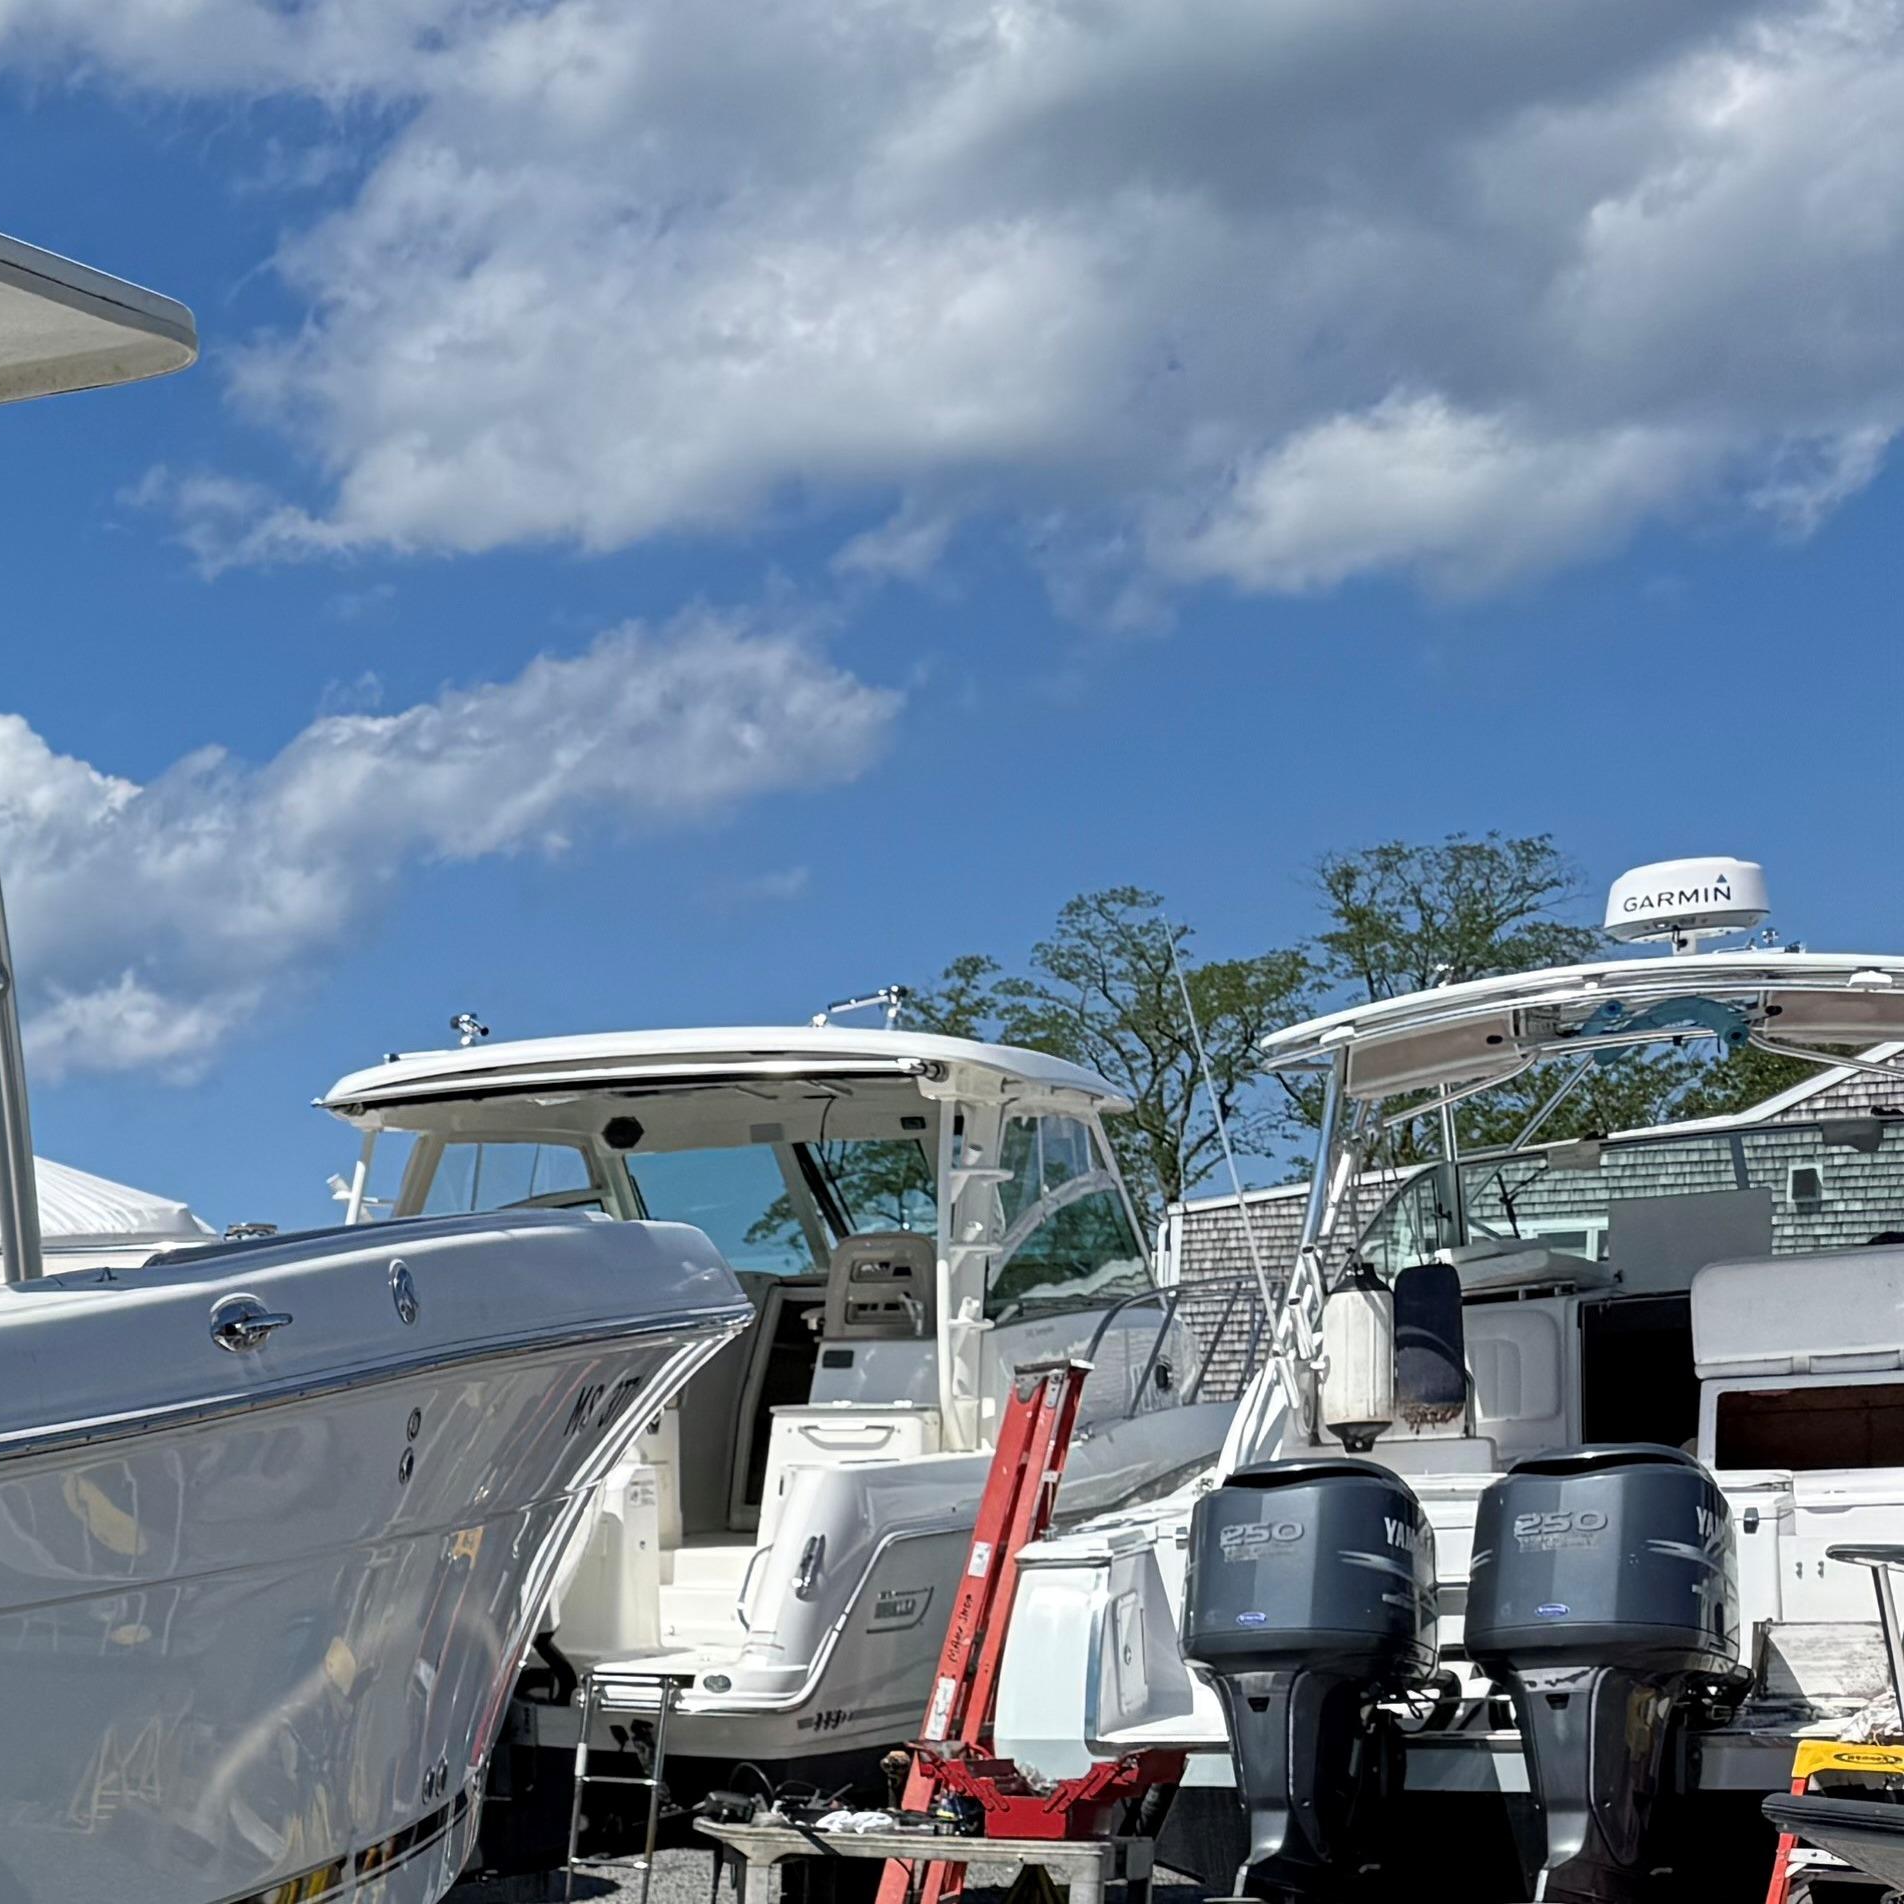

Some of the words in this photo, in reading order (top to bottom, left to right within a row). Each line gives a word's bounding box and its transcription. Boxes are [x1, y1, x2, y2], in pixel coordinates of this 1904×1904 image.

[1623, 885, 1732, 913] GARMIN
[1219, 1520, 1306, 1550] 250
[1514, 1510, 1609, 1539] 250
